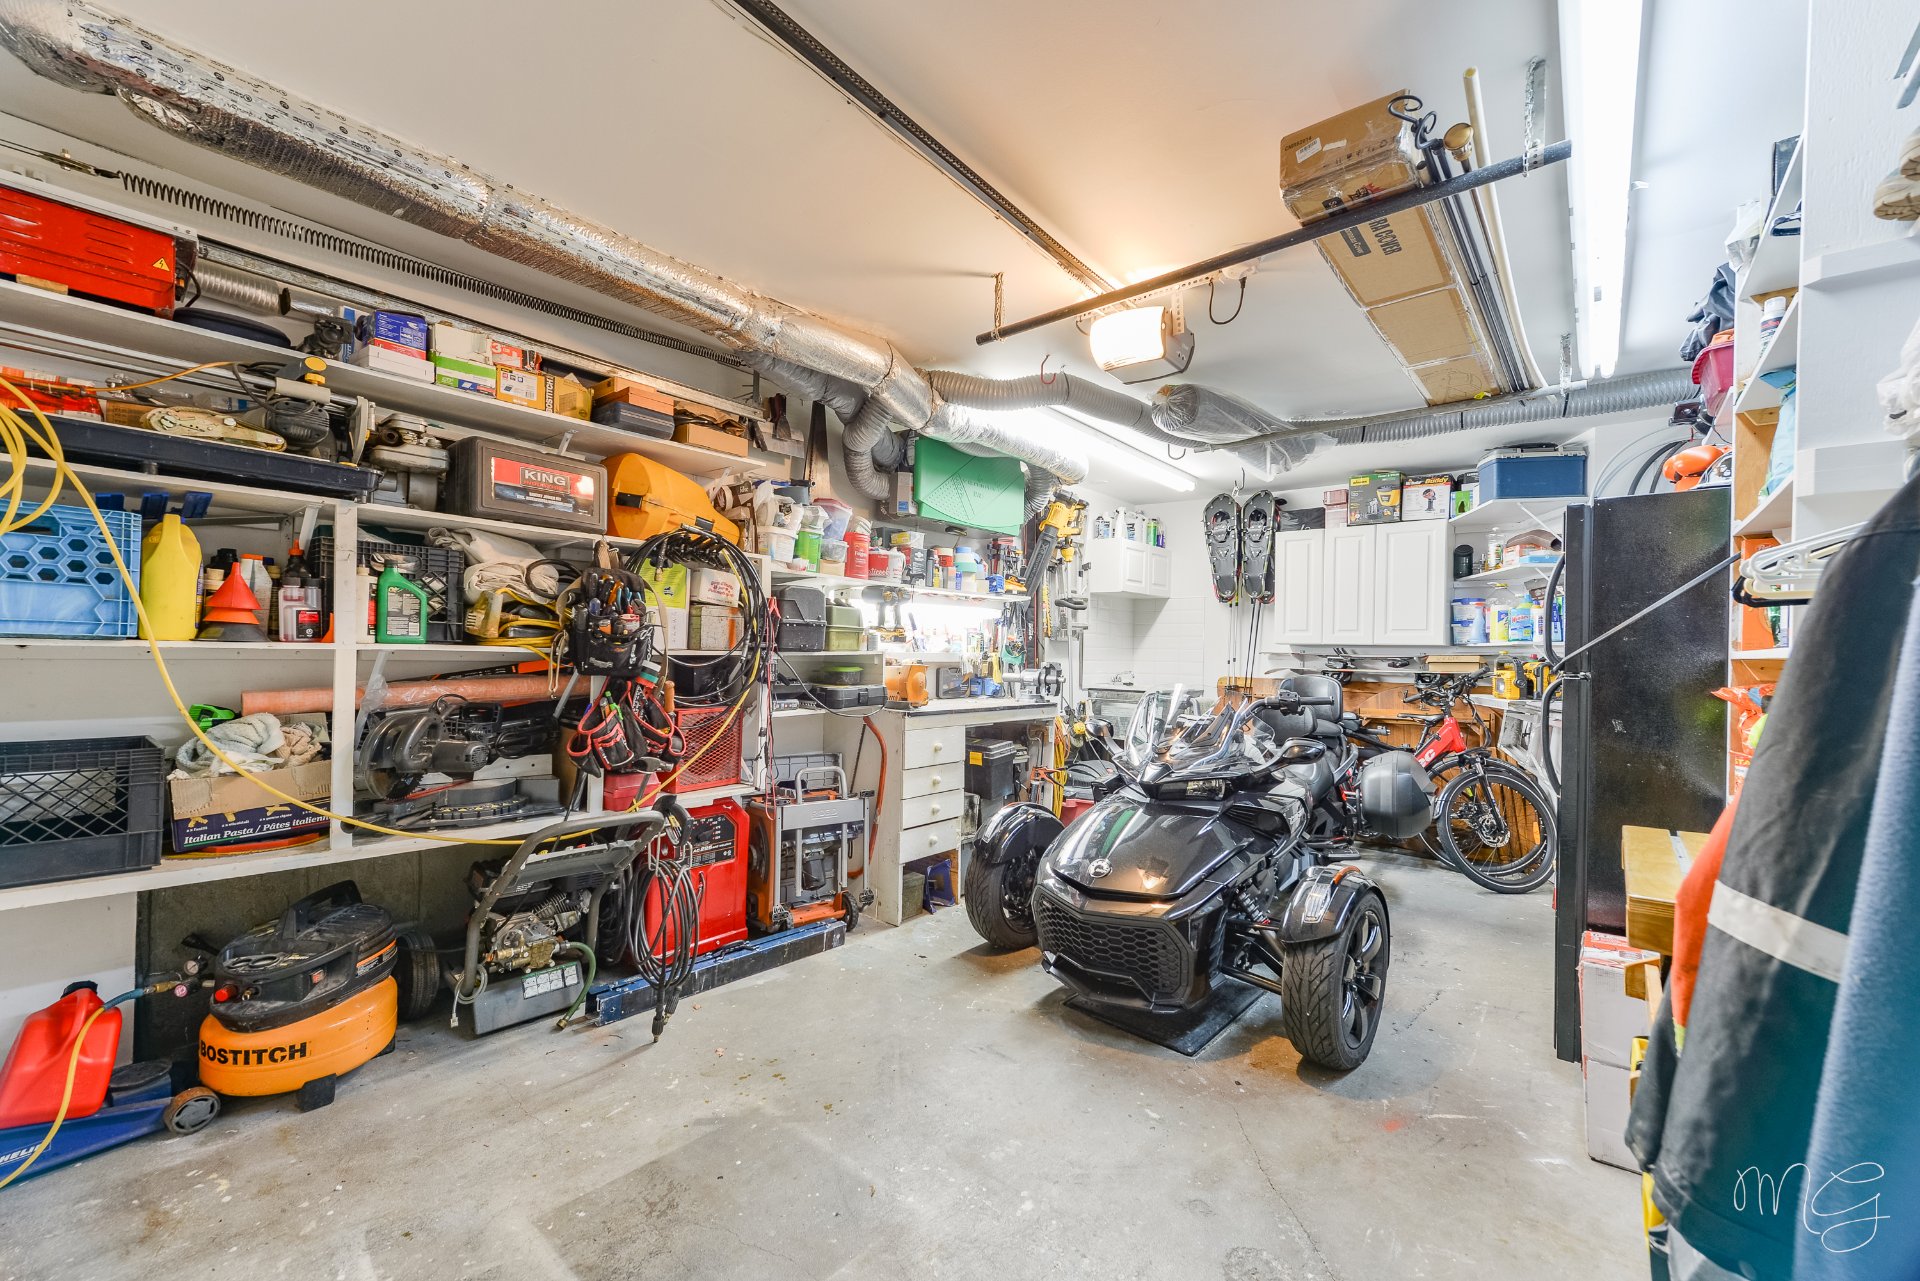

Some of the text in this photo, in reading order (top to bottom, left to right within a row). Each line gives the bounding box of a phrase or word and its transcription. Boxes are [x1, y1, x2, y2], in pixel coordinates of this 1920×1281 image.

[1374, 229, 1402, 256] COVER
[524, 469, 566, 487] KING
[183, 832, 221, 844] Italian
[223, 825, 254, 838] Pasta
[262, 820, 291, 831] Pâtes
[200, 1039, 307, 1066] BOSTITCH
